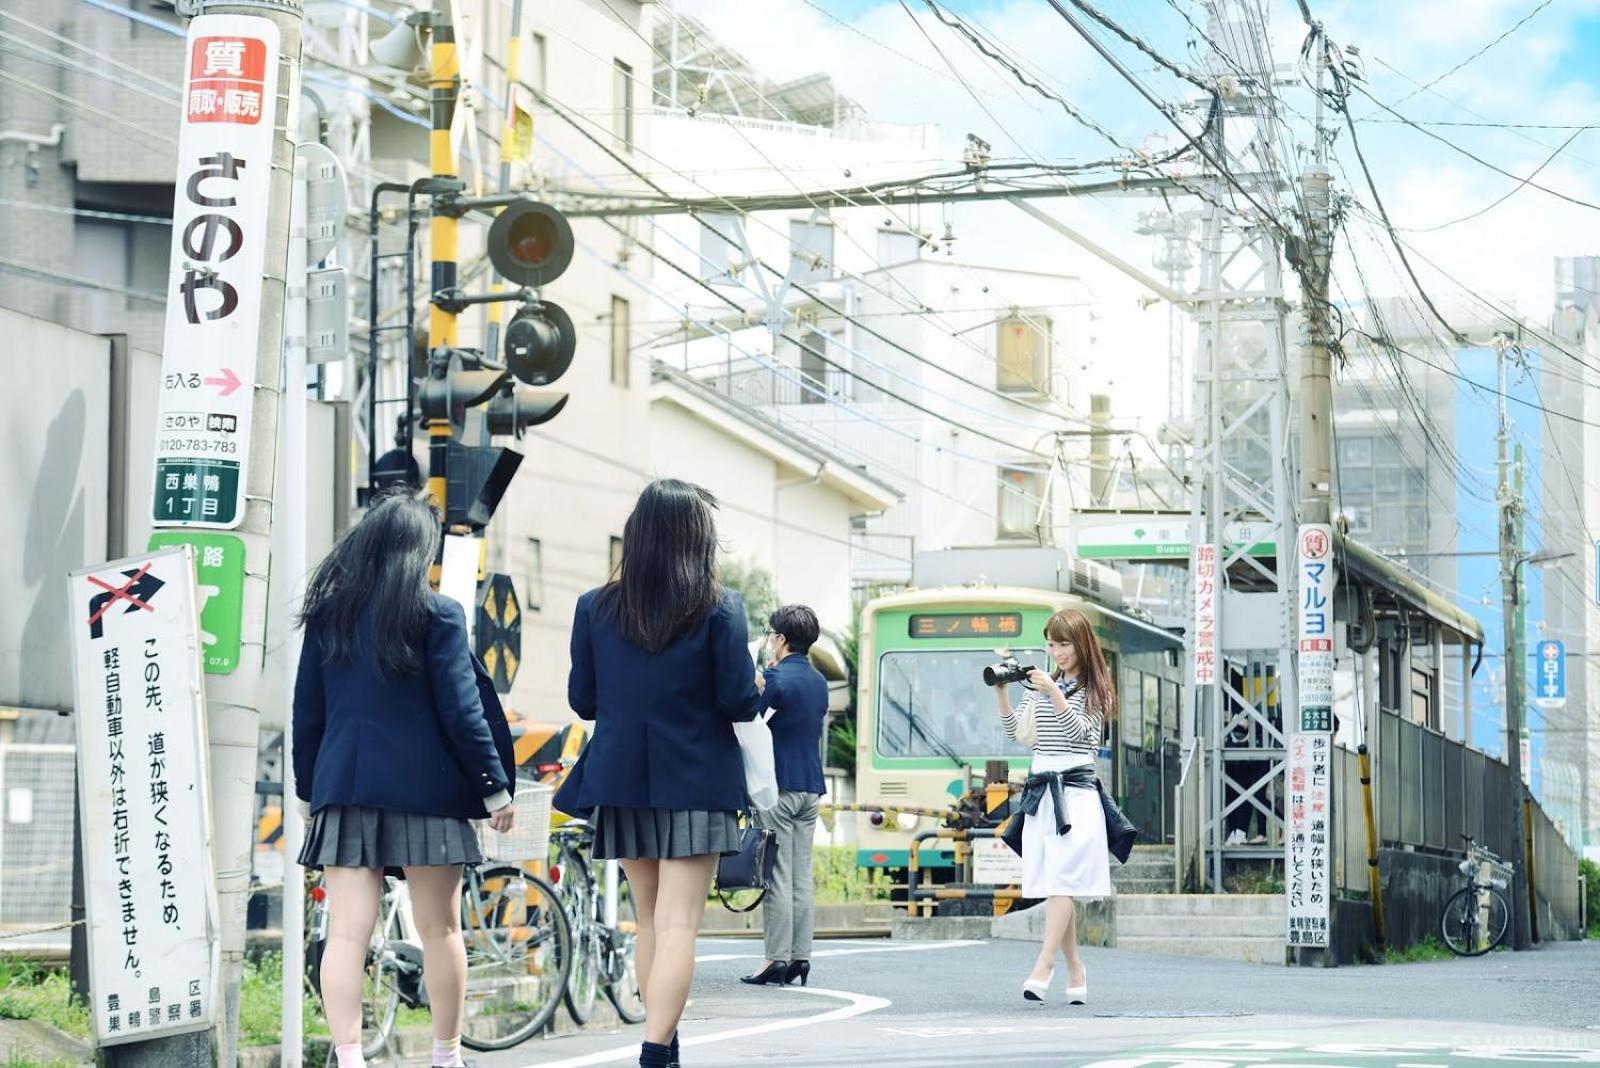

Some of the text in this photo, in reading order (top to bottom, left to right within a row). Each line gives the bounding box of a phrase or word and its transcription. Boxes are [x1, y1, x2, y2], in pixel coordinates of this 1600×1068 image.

[203, 41, 246, 76] 質
[189, 88, 260, 117] 買取・販売
[180, 152, 246, 324] さのや
[165, 415, 200, 428] さのや
[165, 473, 219, 492] 西巣鴨
[165, 497, 218, 516] 1丁目
[1305, 534, 1324, 554] 質
[1196, 546, 1214, 682] 踏切カメラ警戒中
[1304, 563, 1326, 634] マルヨ
[144, 638, 181, 931] この先、道が狭くなるため、
[103, 647, 141, 979] 軽自動車以外は右折できません。
[1289, 930, 1326, 944] 豊島区
